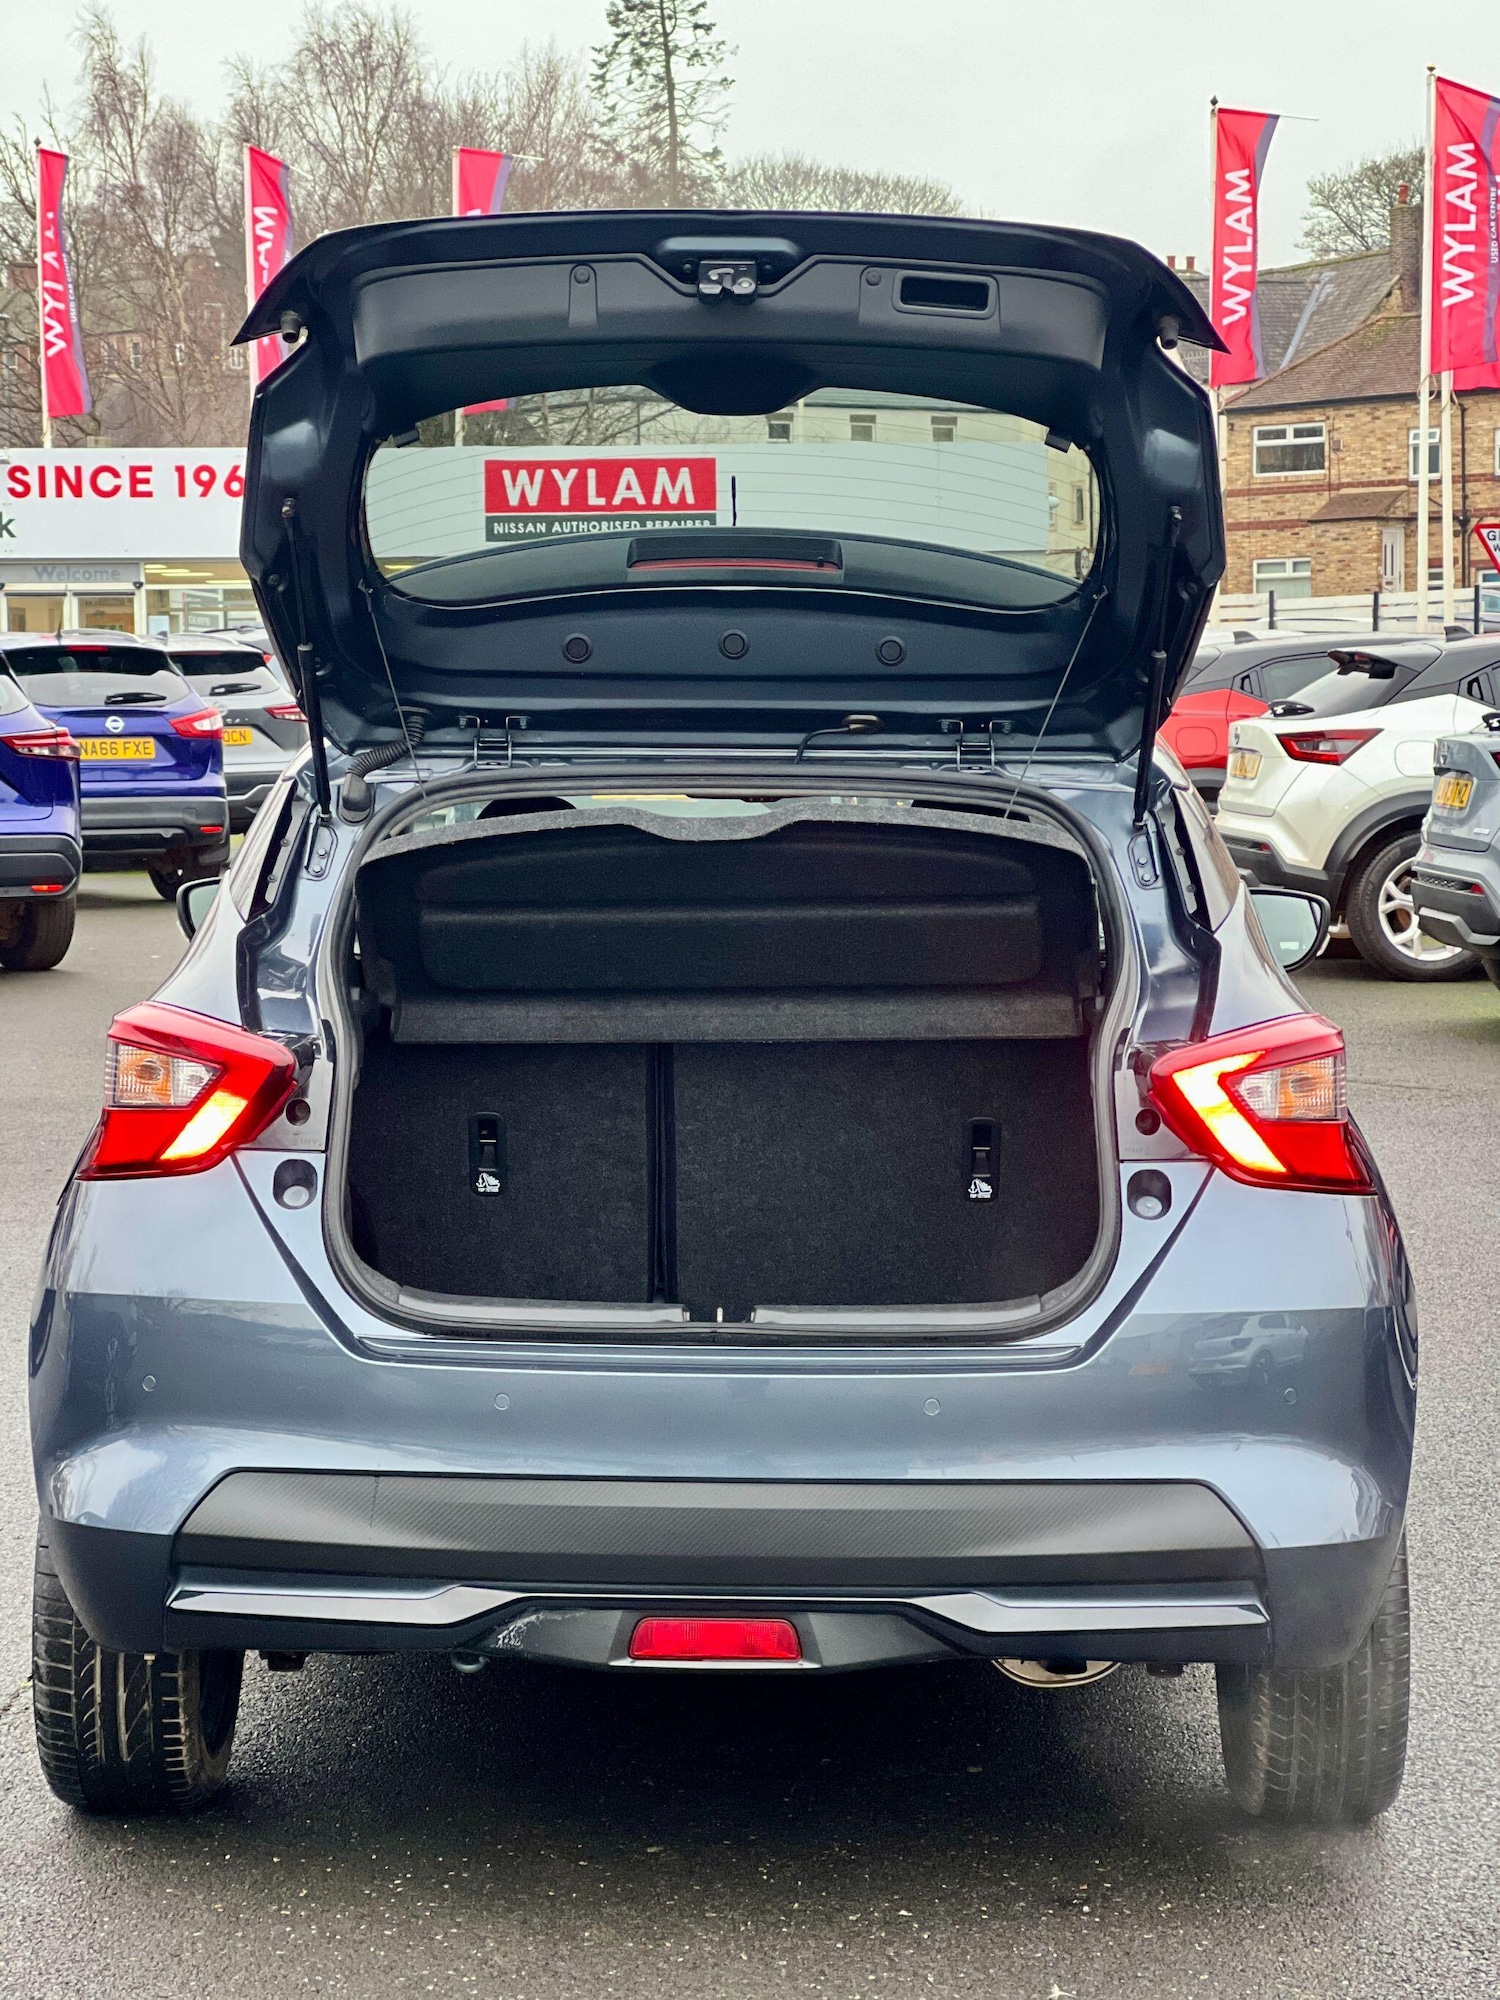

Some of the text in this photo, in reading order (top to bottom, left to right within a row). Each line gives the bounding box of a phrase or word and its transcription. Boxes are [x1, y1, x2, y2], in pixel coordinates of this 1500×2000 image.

[1441, 142, 1478, 308] WYLAM
[1489, 186, 1499, 264] USED CAR CENTRE
[1222, 168, 1254, 326] WYLAM
[7, 465, 154, 498] SINCE
[501, 467, 696, 507] WYLAM
[493, 521, 546, 535] NISSAN
[551, 520, 641, 534] AUTHORISED
[32, 565, 121, 582] Welcome
[79, 740, 152, 757] NA66 FXE
